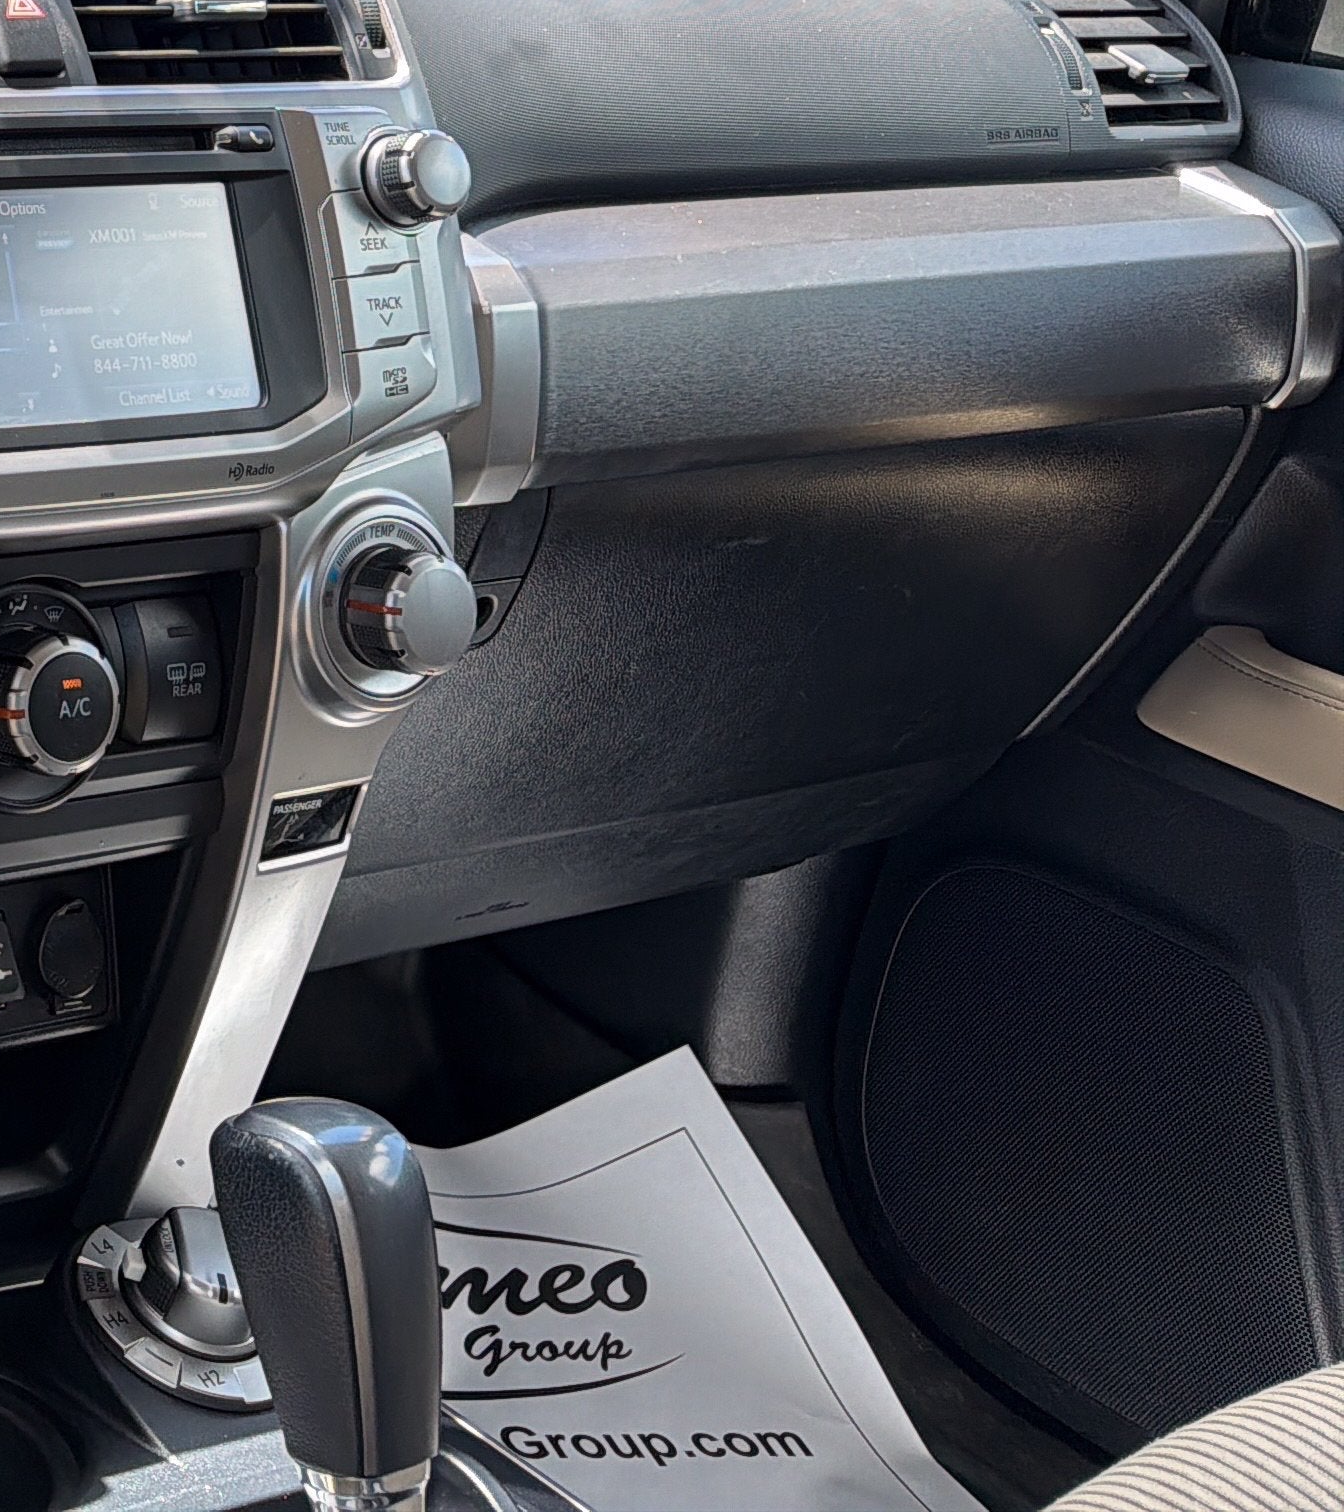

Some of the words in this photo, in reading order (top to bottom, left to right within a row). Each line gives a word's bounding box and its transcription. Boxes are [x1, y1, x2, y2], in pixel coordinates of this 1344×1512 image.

[324, 122, 350, 132] TUNE
[1014, 128, 1059, 139] AIRBAG
[325, 135, 356, 146] SCROLL
[360, 237, 388, 251] SEEK
[366, 296, 402, 311] TRACK
[245, 463, 275, 478] Radio
[369, 524, 396, 539] TEMP
[172, 683, 202, 697] REAR
[59, 696, 92, 719] A/C
[272, 799, 323, 815] PASSENGER
[91, 1238, 114, 1255] L4
[103, 1310, 129, 1329] H4
[464, 1324, 632, 1377] Group
[197, 1369, 226, 1388] H2
